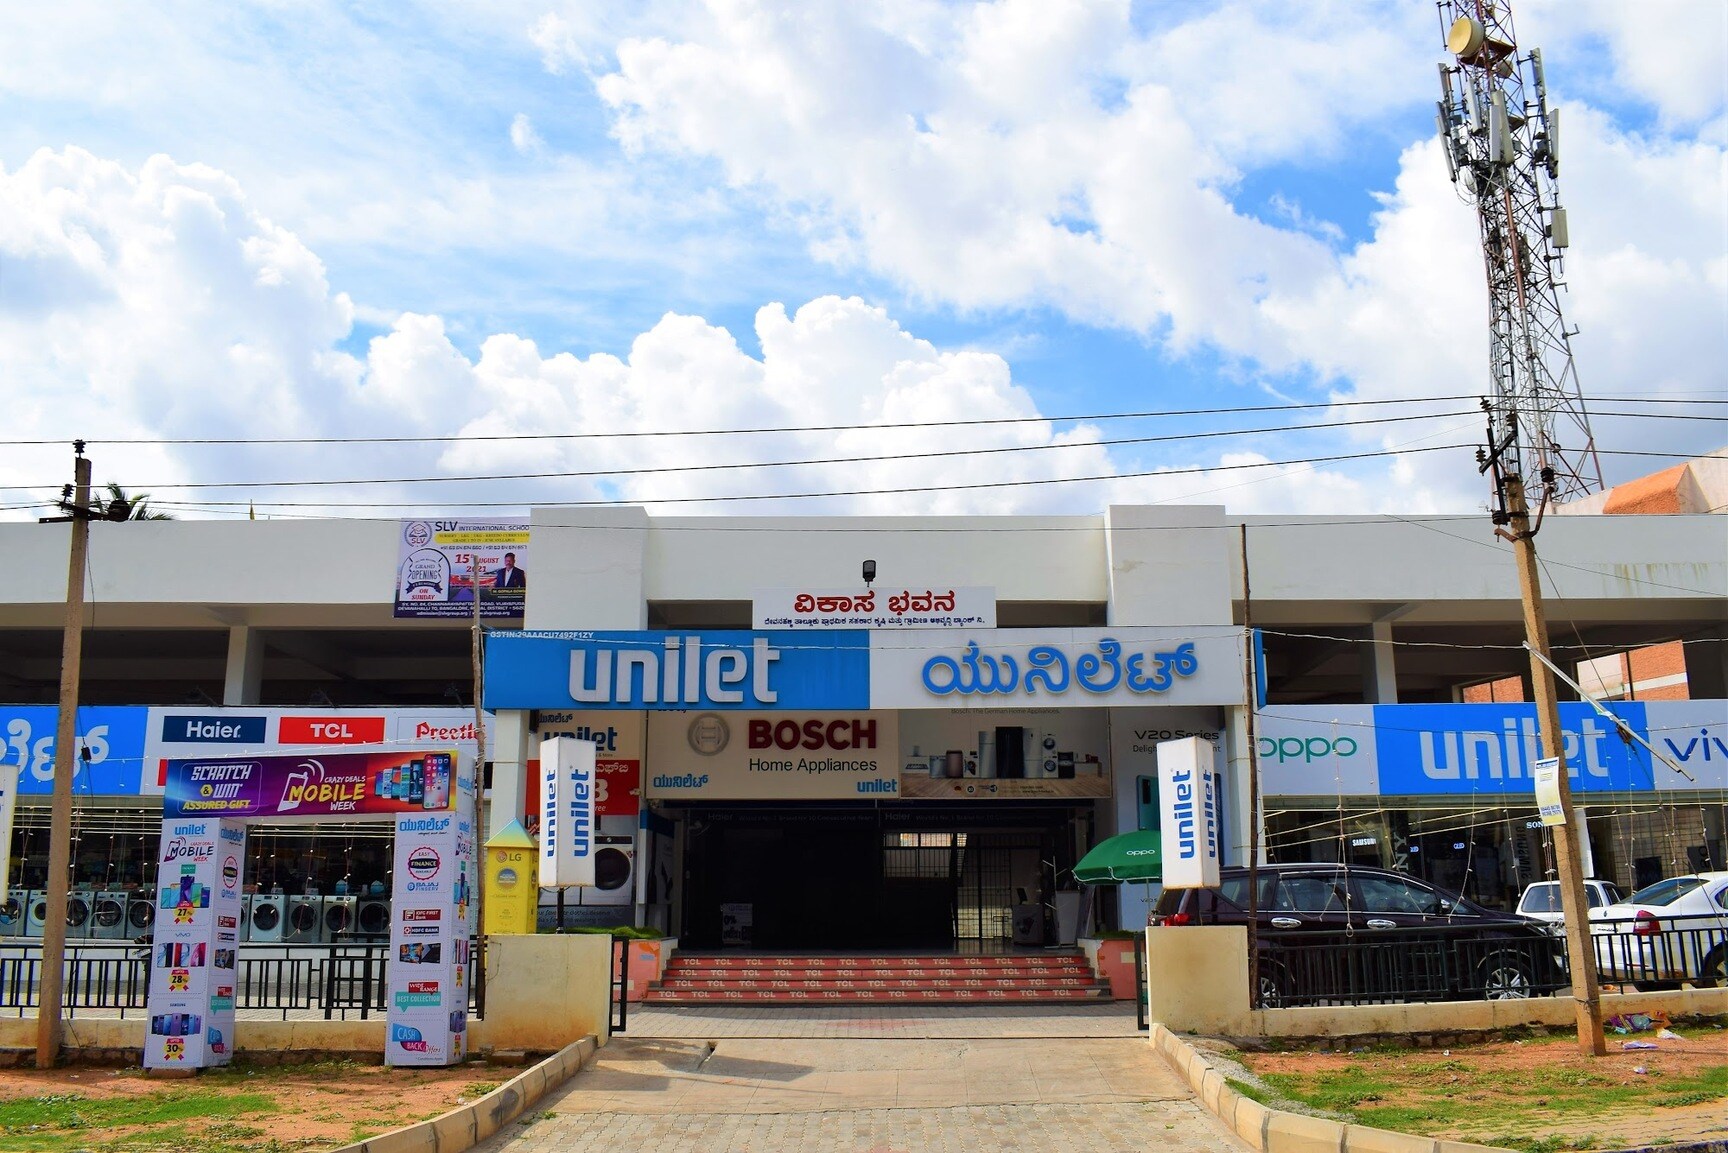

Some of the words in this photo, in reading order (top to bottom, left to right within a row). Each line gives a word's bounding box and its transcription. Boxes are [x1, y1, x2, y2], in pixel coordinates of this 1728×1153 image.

[434, 520, 458, 532] SLV
[411, 570, 438, 580] OPENING
[794, 590, 875, 613] ವಿಕಾಸ
[888, 590, 956, 616] ಭವನ
[568, 636, 780, 703] unilet
[920, 636, 1198, 696] ಯುನಿಲೆಟ್
[186, 721, 241, 738] Haier
[310, 723, 353, 738] TCL
[416, 722, 485, 740] Preeth
[748, 719, 876, 751] BOSCH
[1134, 730, 1172, 740] V20
[1259, 736, 1358, 764] oppo
[190, 764, 252, 780] SCRATCH
[749, 758, 793, 772] Home
[798, 758, 877, 774] Appliances
[653, 773, 710, 790] ಯುನಿಲೆಟ್
[857, 778, 897, 793] unilet
[202, 786, 210, 795] &
[212, 784, 242, 798] WIN
[290, 783, 366, 804] MOBILE
[182, 800, 228, 810] ASSURED
[228, 800, 251, 808] GIFT
[330, 801, 356, 811] WEEK
[570, 768, 589, 857] unilet
[546, 769, 558, 858] unilet
[884, 812, 911, 821] Haier
[1172, 769, 1194, 859] unilet
[1203, 769, 1216, 858] unilet
[174, 824, 206, 835] unilet
[400, 818, 450, 832] ಯುನಿಲೆಟ್
[1526, 821, 1544, 829] SON
[170, 846, 214, 858] MOBILE
[509, 853, 522, 862] LG
[398, 1028, 416, 1040] CASH
